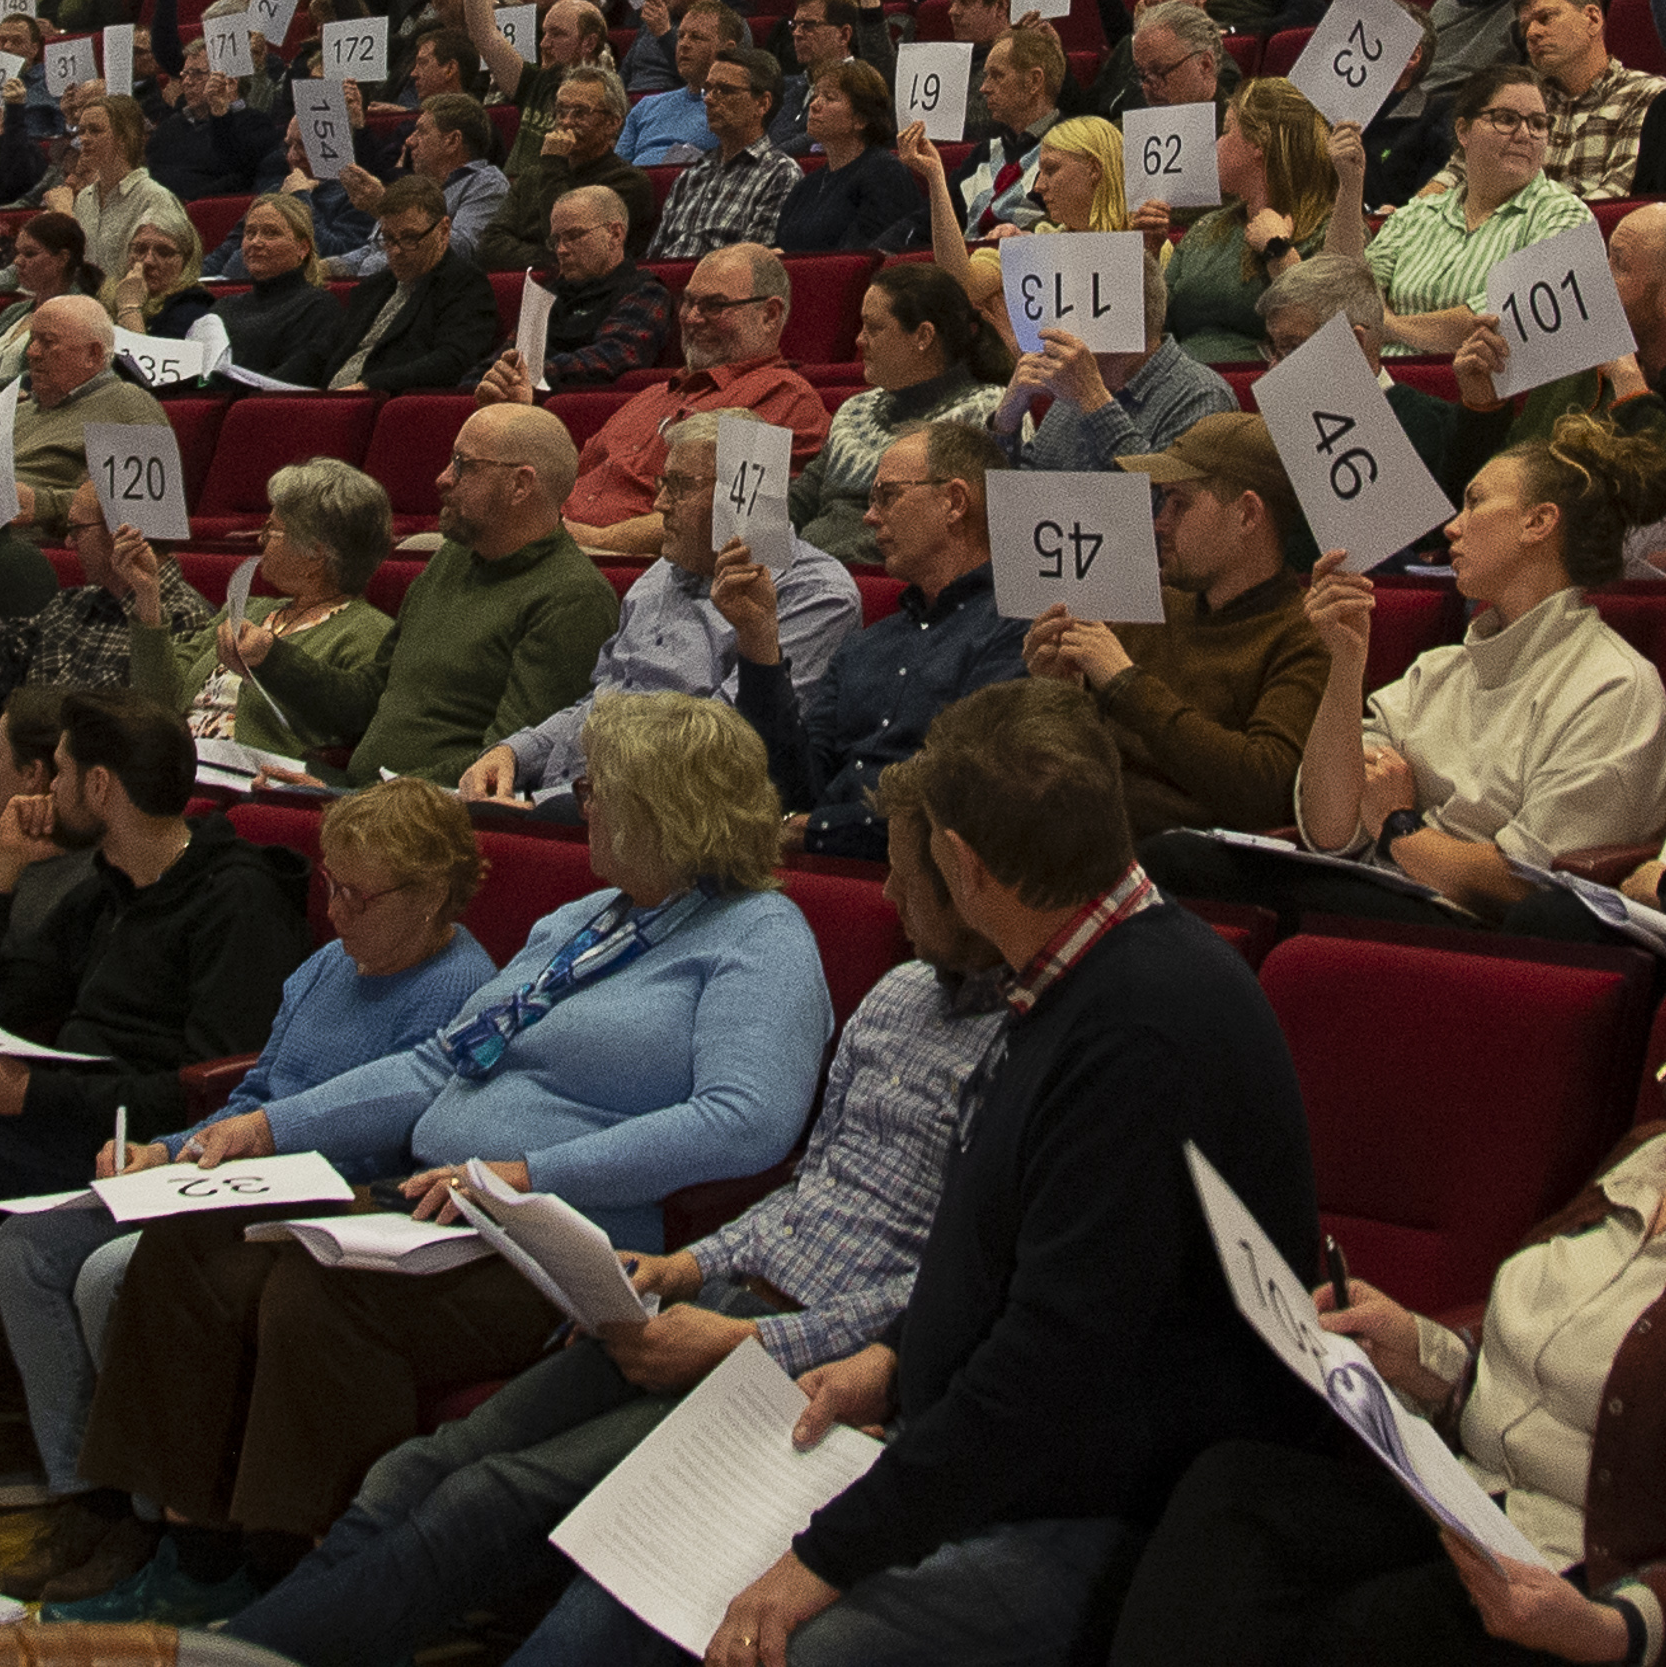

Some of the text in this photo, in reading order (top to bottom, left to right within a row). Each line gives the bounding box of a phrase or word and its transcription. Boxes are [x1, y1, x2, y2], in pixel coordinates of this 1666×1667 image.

[57, 55, 78, 78] 31
[333, 35, 374, 64] 172
[1334, 19, 1383, 88] 23
[310, 99, 338, 161] 154
[1143, 133, 1183, 175] 62
[1020, 271, 1111, 321] 113
[1502, 269, 1590, 344] 101
[121, 348, 180, 382] 35
[102, 455, 166, 502] 120
[1311, 408, 1379, 502] 46
[728, 459, 766, 517] 47
[1032, 520, 1104, 581] 45
[168, 1174, 271, 1199] 32
